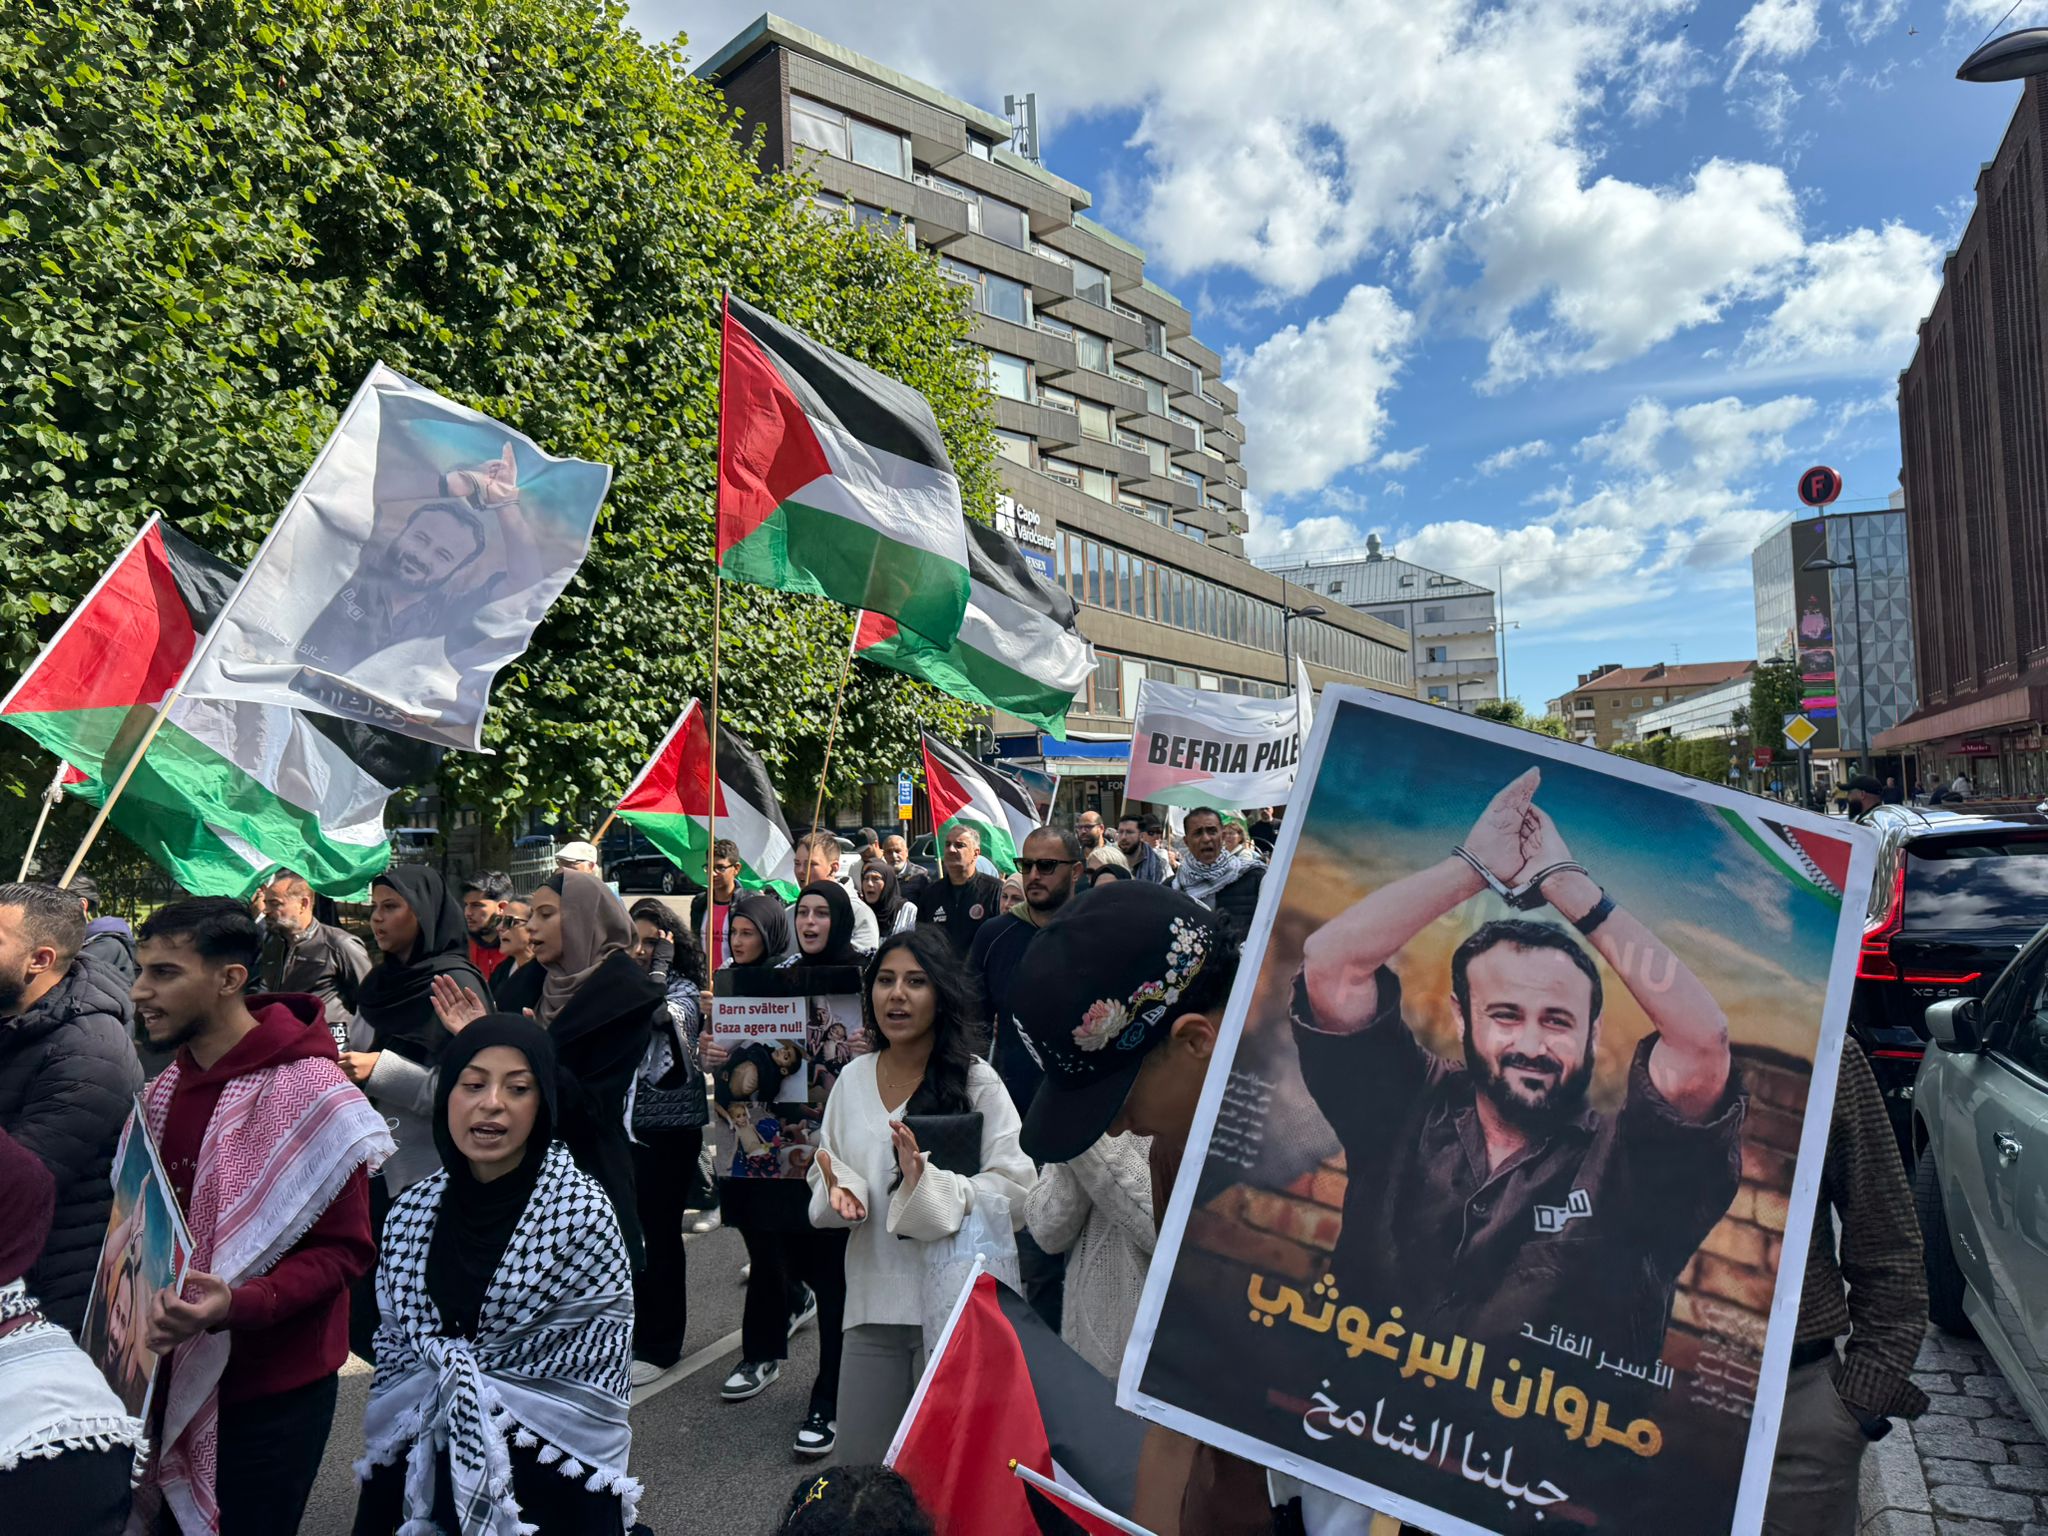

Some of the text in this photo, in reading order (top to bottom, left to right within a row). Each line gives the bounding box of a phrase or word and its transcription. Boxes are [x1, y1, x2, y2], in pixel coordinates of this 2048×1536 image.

[1811, 475, 1825, 498] F
[1016, 503, 1041, 525] Capio
[1147, 731, 1249, 774] BEFRIA
[714, 1021, 802, 1036] Gaza agera nu!!
[719, 1003, 745, 1015] Barn
[748, 1002, 790, 1015] svälter
[1246, 1272, 1485, 1391] البرغوثي
[1519, 1317, 1675, 1391] الأسير القائد
[1490, 1356, 1664, 1457] مروان
[1302, 1379, 1570, 1522] جبلنا الشامخ
